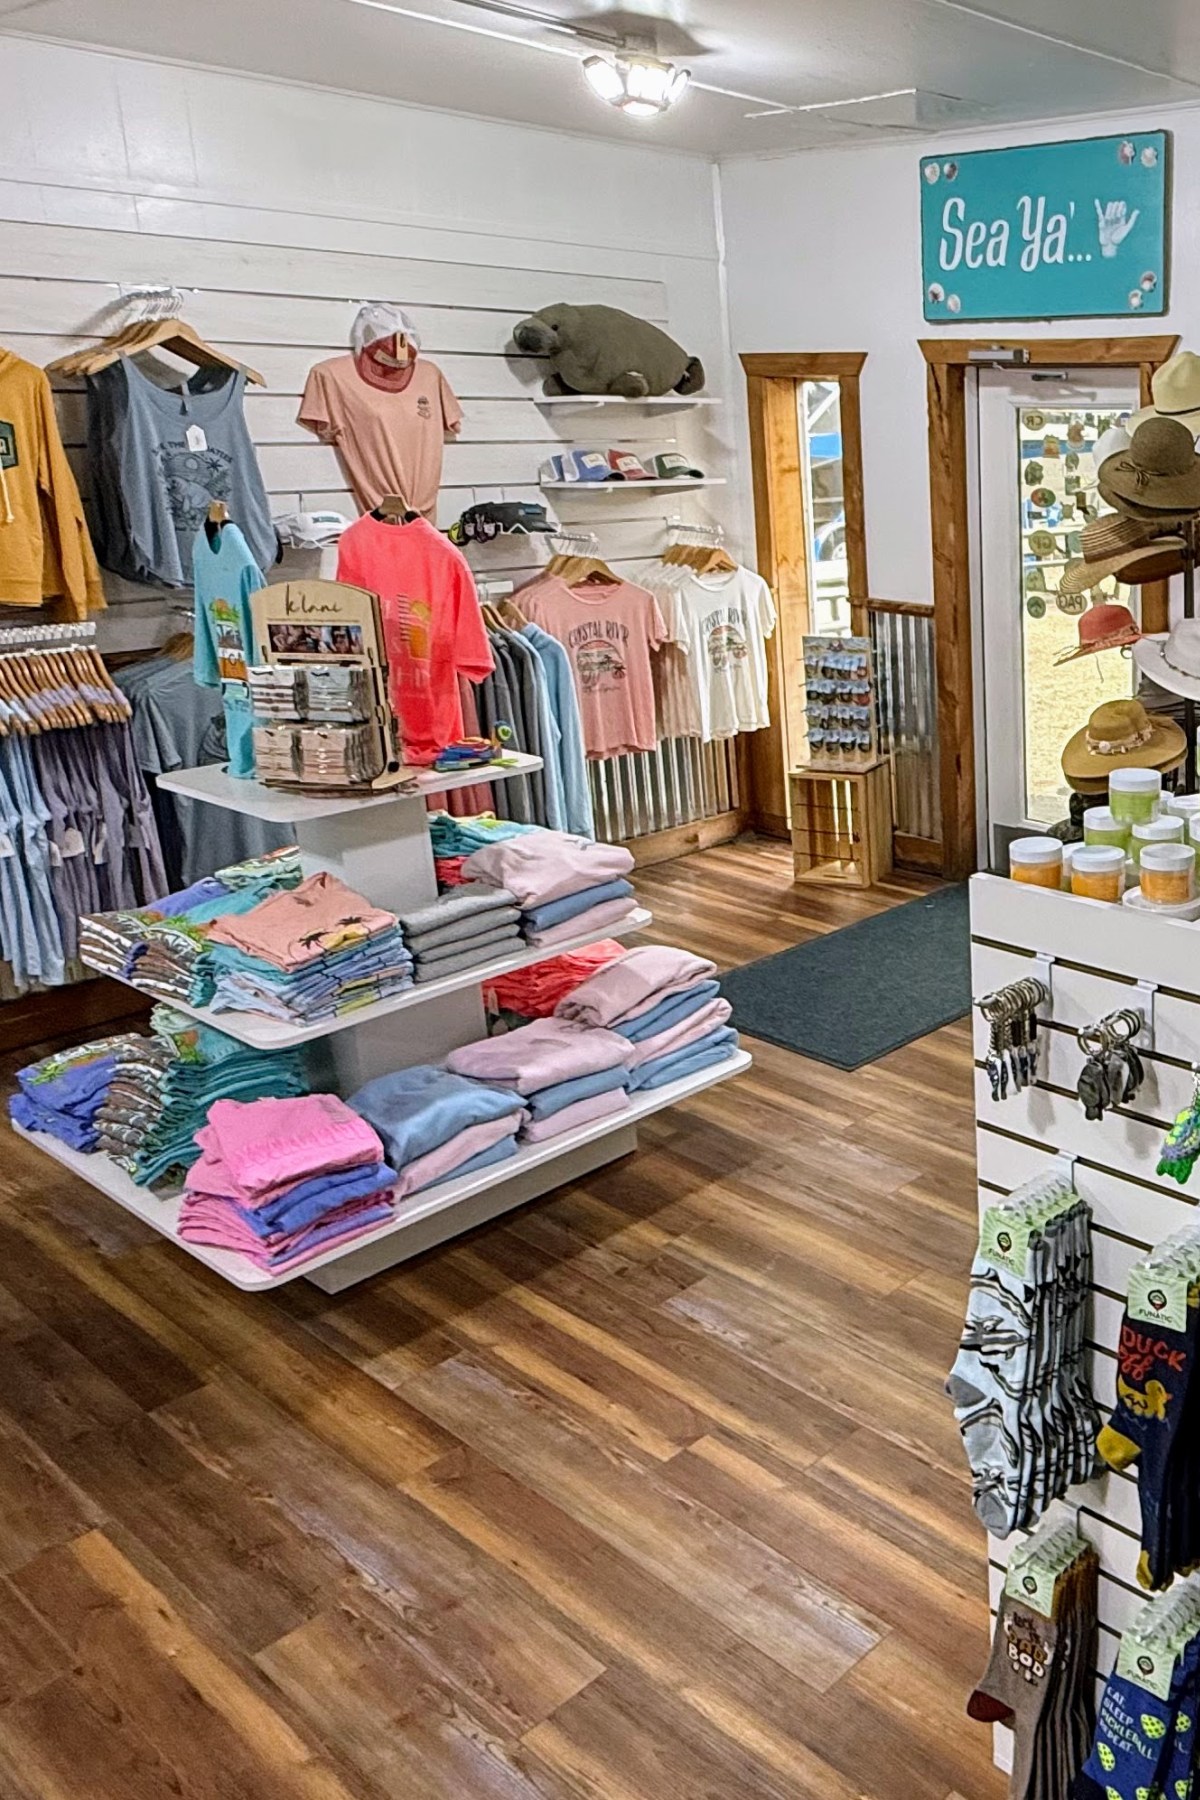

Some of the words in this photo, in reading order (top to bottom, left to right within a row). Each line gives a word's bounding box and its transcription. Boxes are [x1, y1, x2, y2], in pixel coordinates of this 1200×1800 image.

[939, 196, 1008, 271] Sea
[1138, 1308, 1174, 1323] FUNATIC
[1120, 1324, 1186, 1373] DUCK
[1008, 1643, 1046, 1678] BOD
